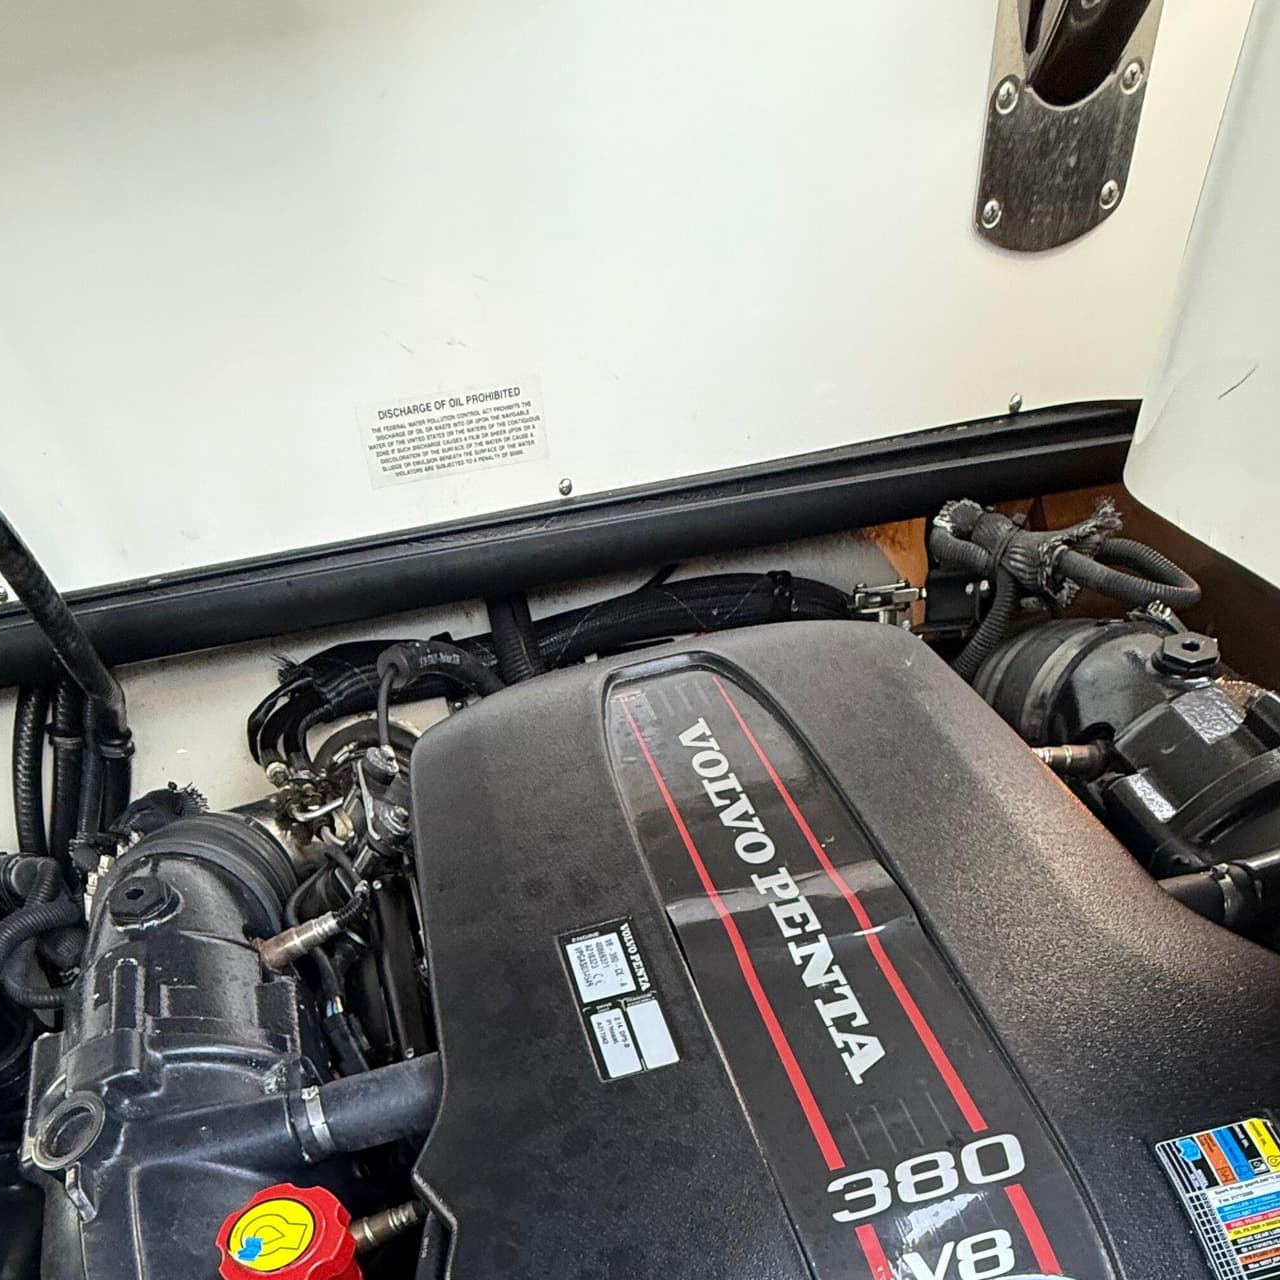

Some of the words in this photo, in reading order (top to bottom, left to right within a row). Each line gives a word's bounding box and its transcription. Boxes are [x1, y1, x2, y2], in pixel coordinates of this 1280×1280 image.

[377, 403, 432, 420] DISCHARGE
[433, 400, 446, 410] OF
[448, 397, 463, 407] OIL
[465, 388, 521, 404] PROHIBITED
[678, 718, 776, 864] VOLVO
[750, 866, 887, 1085] PENTA
[620, 922, 638, 954] VOLVO
[630, 953, 651, 991] PENTA
[825, 1132, 1026, 1222] 380
